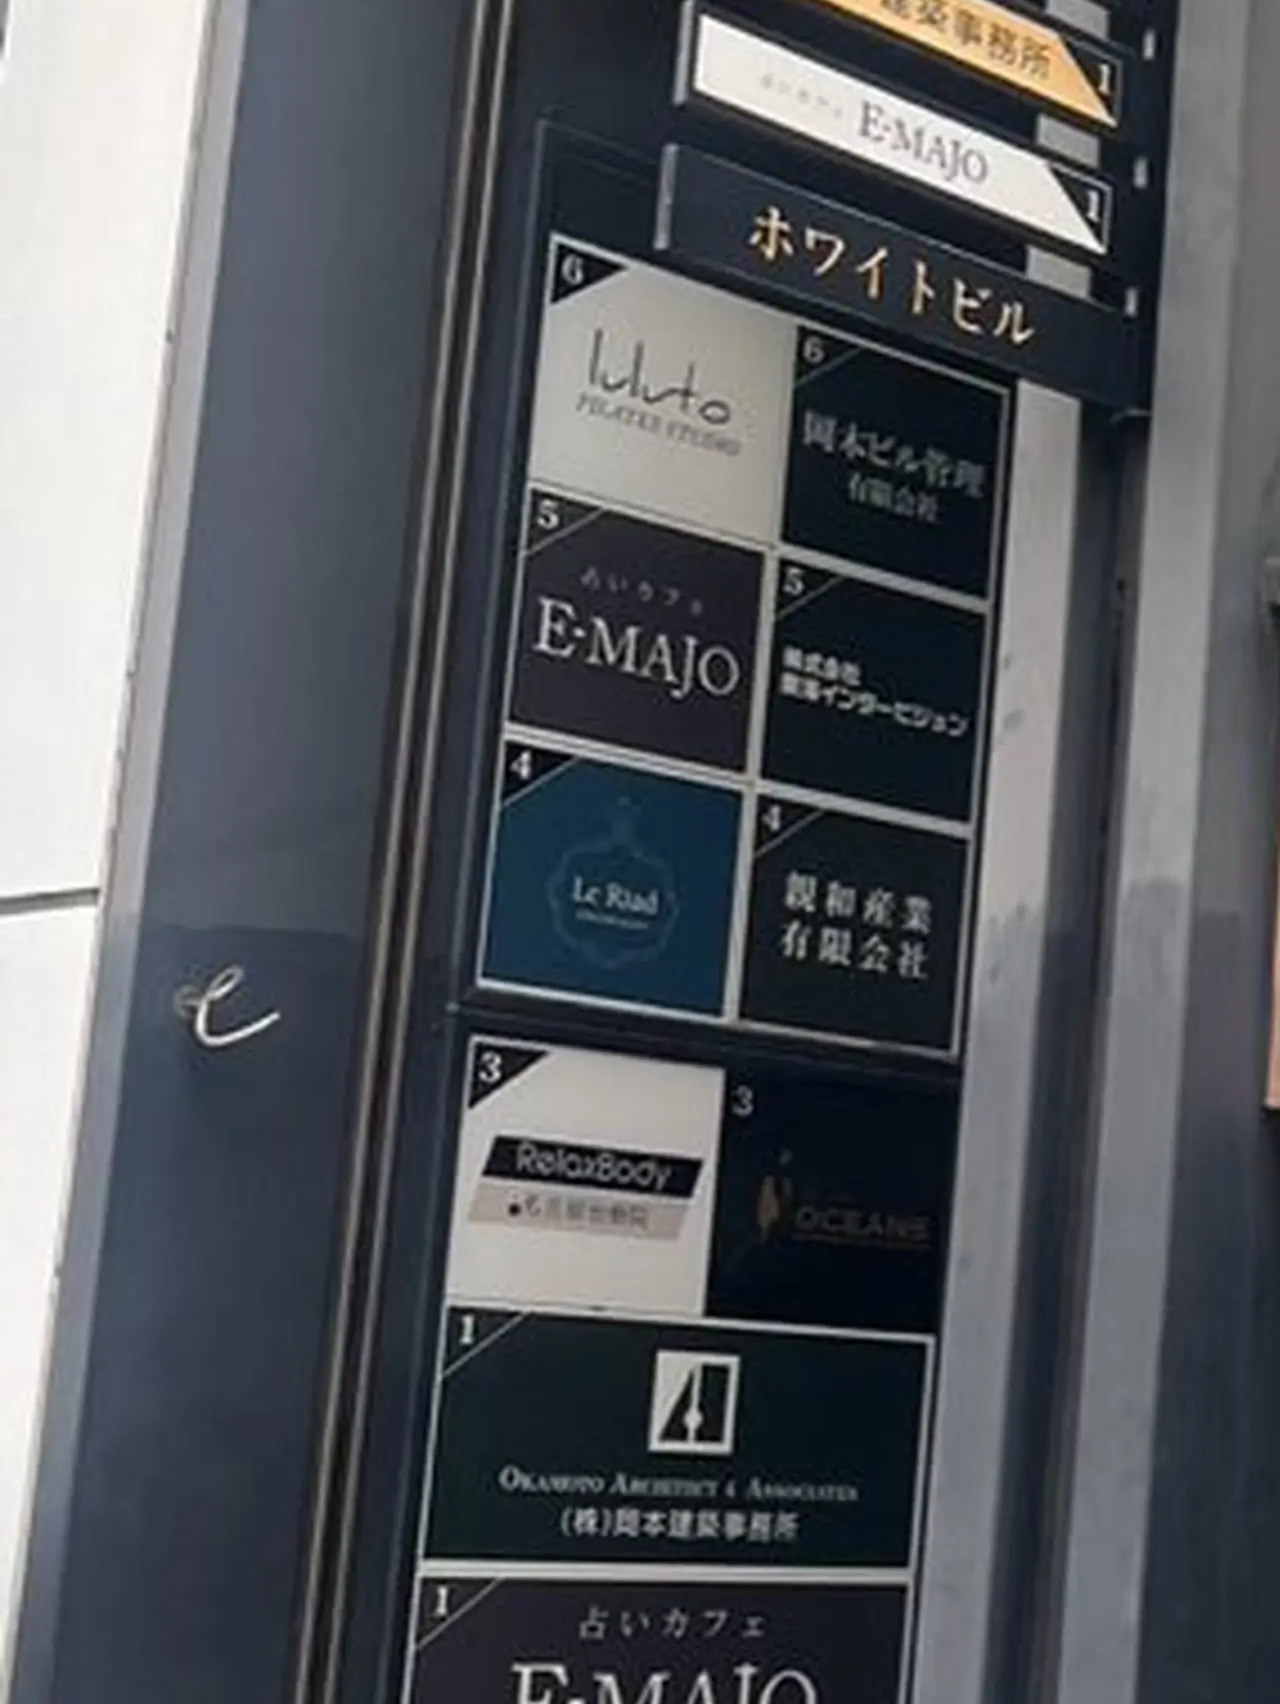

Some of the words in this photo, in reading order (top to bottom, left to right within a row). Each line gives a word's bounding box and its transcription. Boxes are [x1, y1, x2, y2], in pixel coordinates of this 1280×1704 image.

[1099, 63, 1111, 91] 1
[858, 100, 990, 184] E-MAJO
[1087, 191, 1101, 222] 1
[562, 257, 584, 284] 6
[749, 206, 1036, 345] ホワイトビル
[805, 336, 824, 361] 6
[537, 499, 559, 530] 5
[784, 569, 803, 594] 5
[533, 596, 740, 699] E-MAJO
[511, 751, 532, 778] 4
[763, 805, 781, 831] 4
[785, 870, 934, 936] 親和産業
[781, 923, 928, 980] 有限会社
[479, 1055, 501, 1083] 3
[733, 1086, 754, 1117] 3
[516, 1141, 671, 1191] RelaxBody
[460, 1315, 475, 1345] 1
[435, 1586, 449, 1617] 1
[579, 1605, 766, 1639] 占いカフェ
